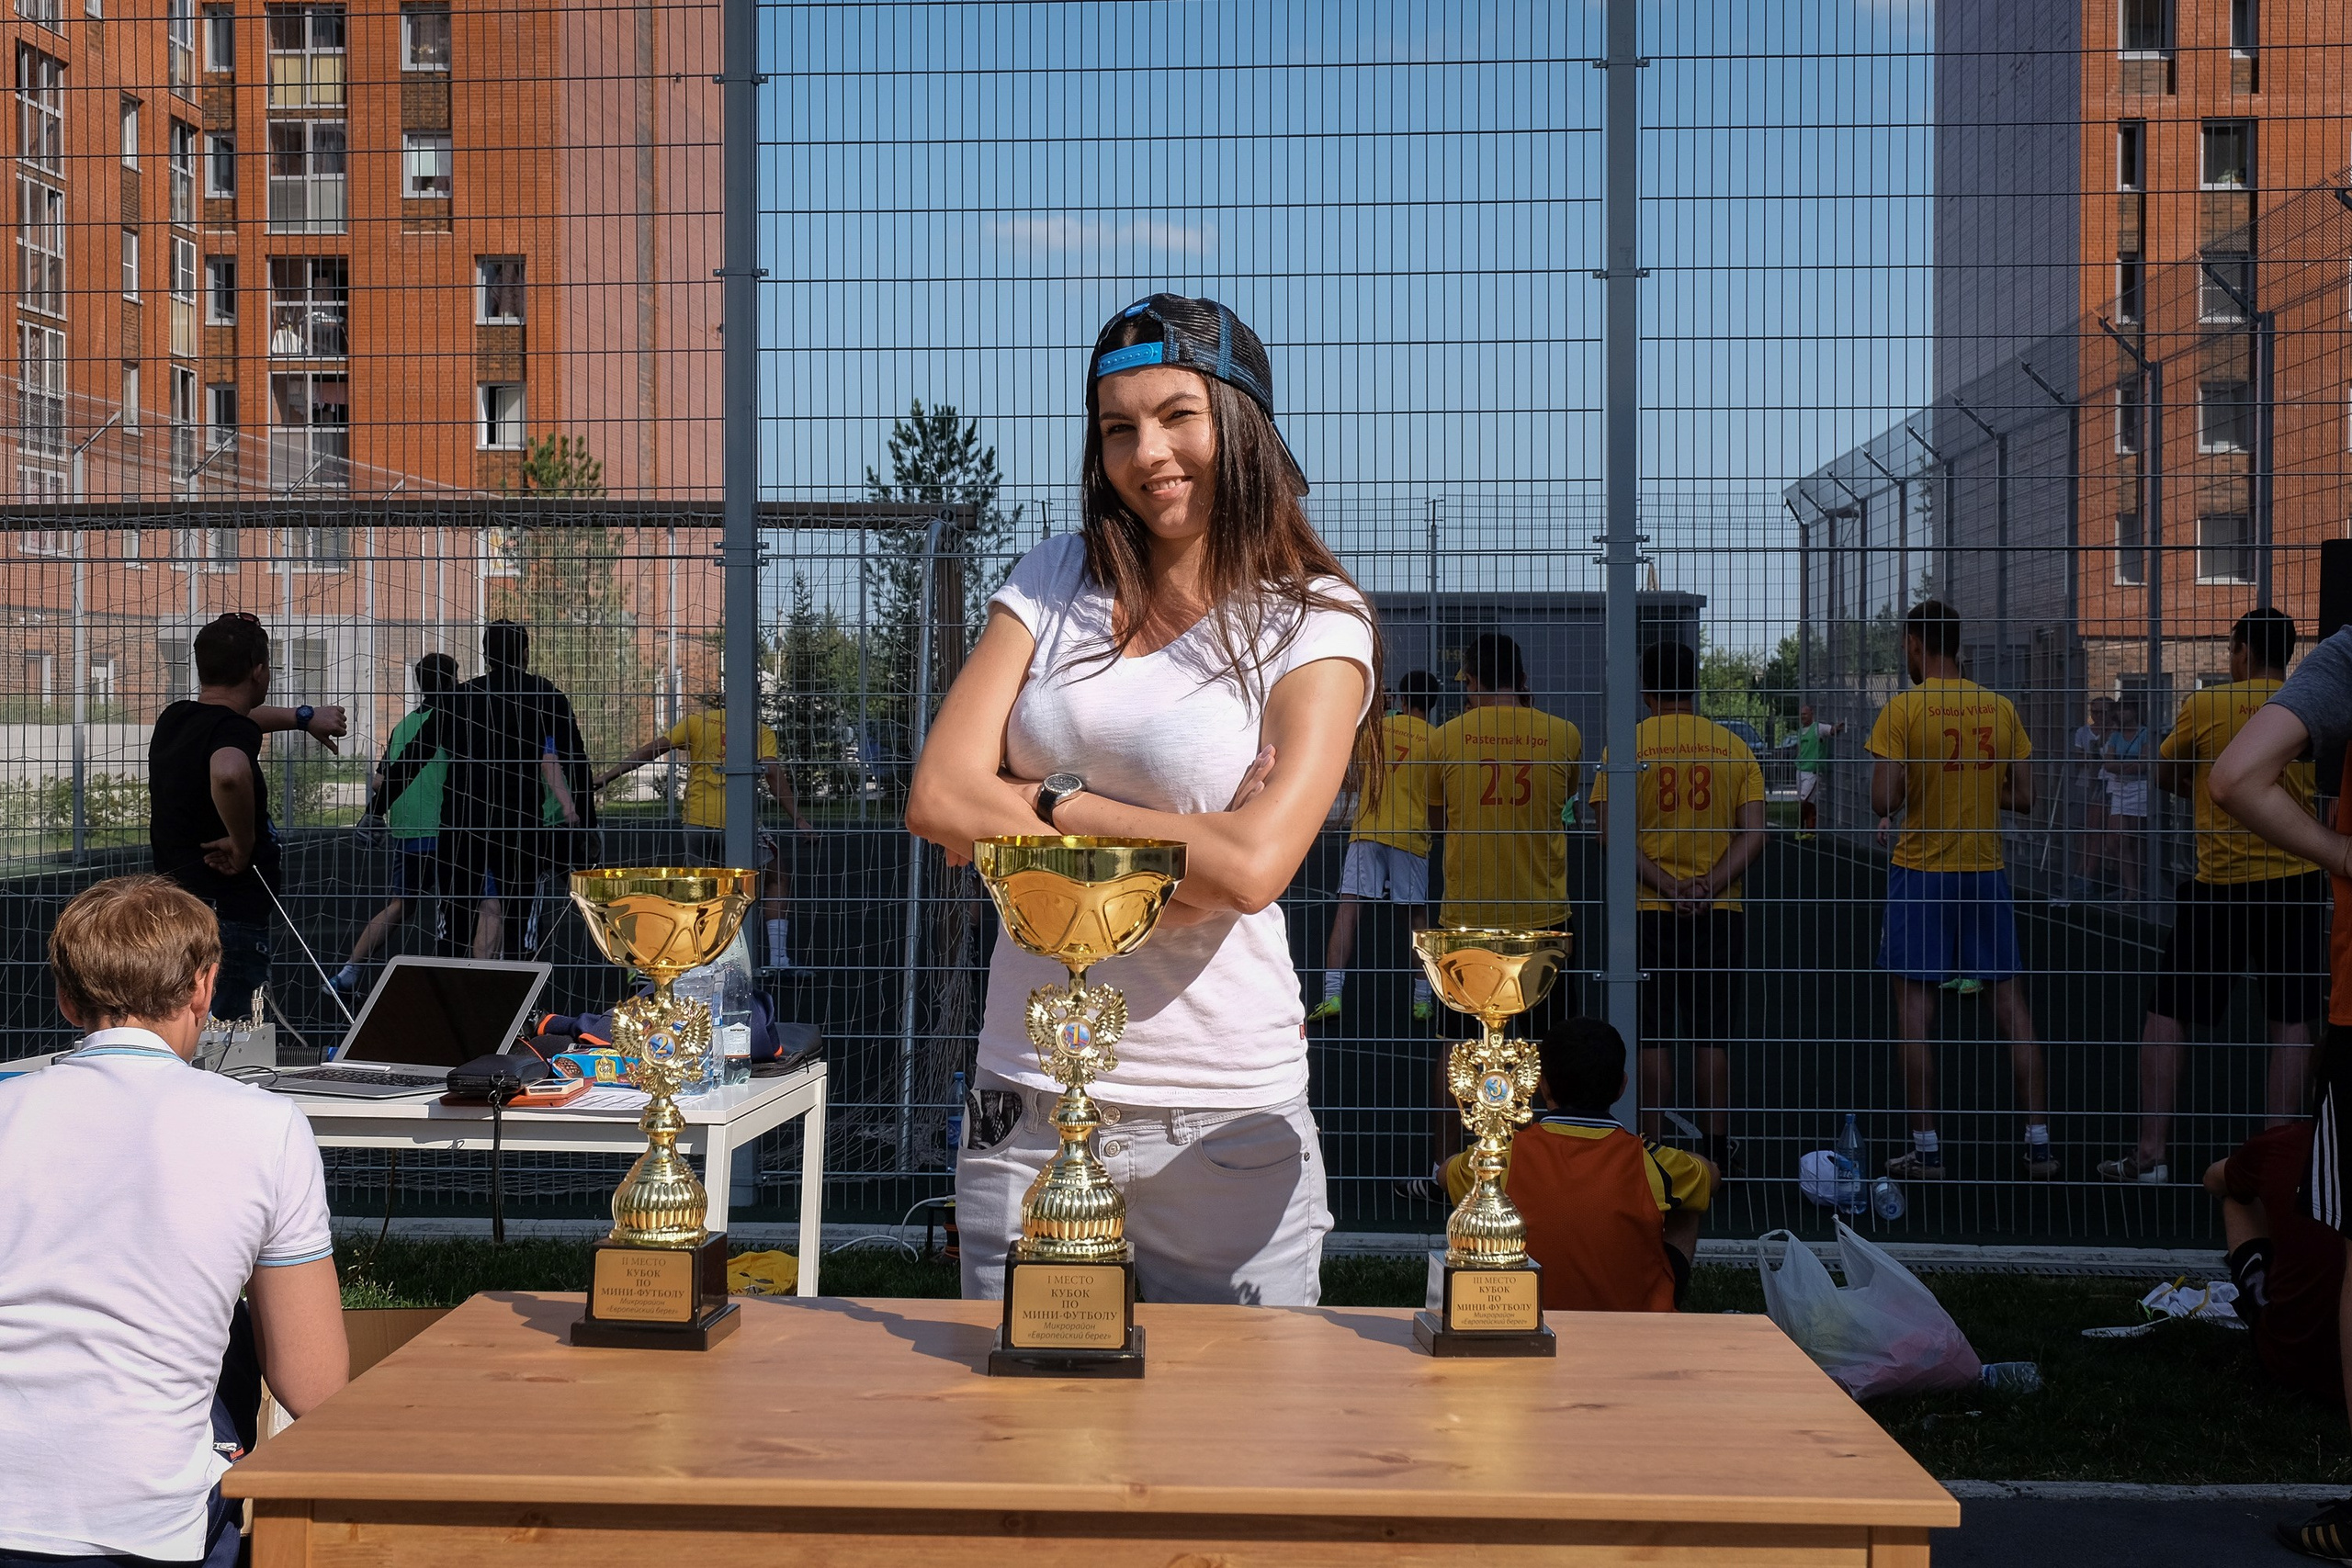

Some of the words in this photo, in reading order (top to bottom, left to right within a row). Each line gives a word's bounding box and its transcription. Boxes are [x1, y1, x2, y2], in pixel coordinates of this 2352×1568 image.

[1928, 705, 1964, 716] Sokolov
[1464, 734, 1522, 745] Pasternak
[1526, 735, 1548, 748] Igor
[1635, 746, 1676, 759] ochnev
[1679, 743, 1731, 757] Aleksand
[1942, 727, 1996, 772] 23
[1390, 745, 1408, 773] 7
[1479, 758, 1532, 807] 23
[1656, 765, 1712, 812] 88
[1072, 1024, 1080, 1045] 1
[655, 1036, 668, 1054] 2
[1490, 1078, 1502, 1097] 3
[631, 1258, 666, 1267] МЕСТО
[627, 1269, 661, 1278] КУБОК
[636, 1279, 650, 1287] ПО
[1054, 1275, 1094, 1284] МЕСТО
[1484, 1276, 1517, 1284] МЕСТО
[601, 1288, 684, 1298] МИНИ-ФУТБОЛУ
[1051, 1289, 1091, 1298] КУБОК
[1479, 1286, 1510, 1294] КУБОК
[1061, 1300, 1079, 1309] ПО
[1456, 1303, 1532, 1312] МИНИ-ФУТБОЛУ
[1022, 1310, 1118, 1321] МИНИ-ФУТБОЛУ
[1043, 1322, 1096, 1332] Микрорайон
